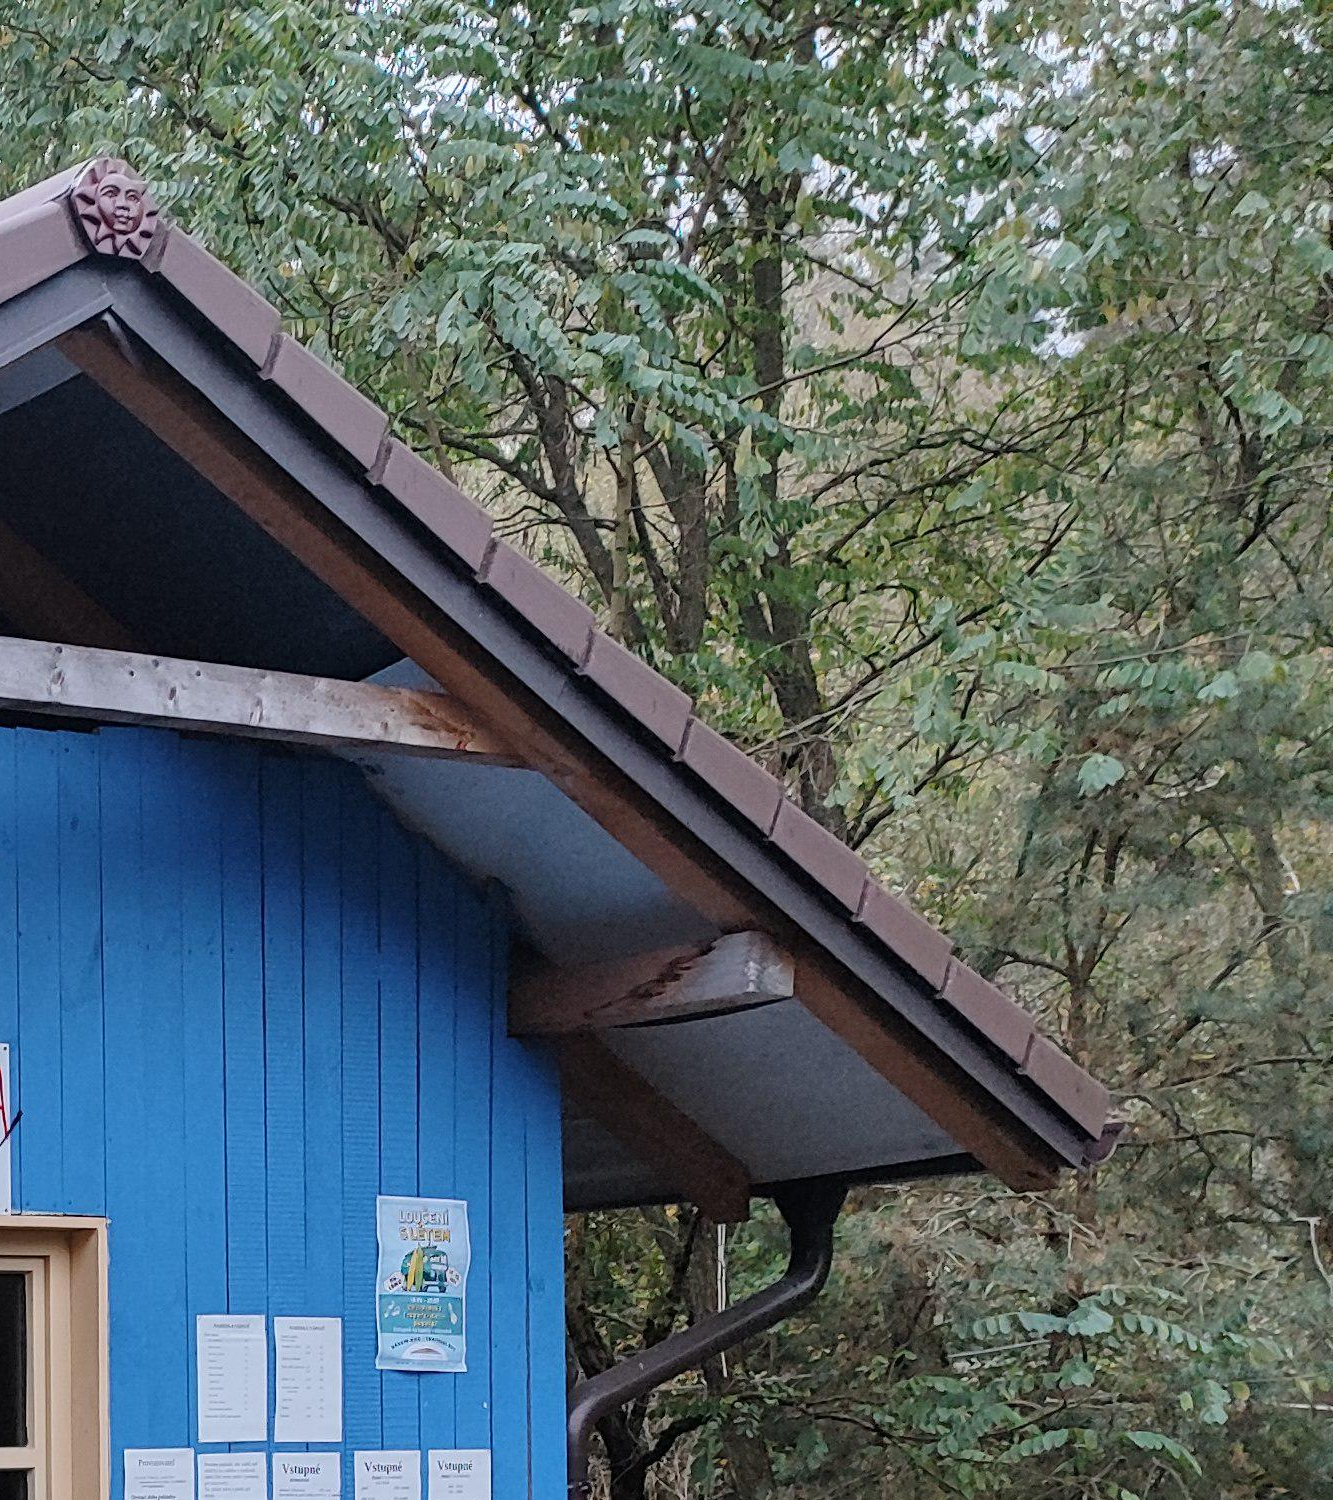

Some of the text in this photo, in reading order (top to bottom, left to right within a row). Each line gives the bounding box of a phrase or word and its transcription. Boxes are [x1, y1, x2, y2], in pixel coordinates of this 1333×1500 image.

[399, 1208, 450, 1226] LOUČENÍ
[282, 1463, 321, 1477] Vstupné
[364, 1461, 403, 1474] Vstupné
[437, 1459, 474, 1473] Vstupné
